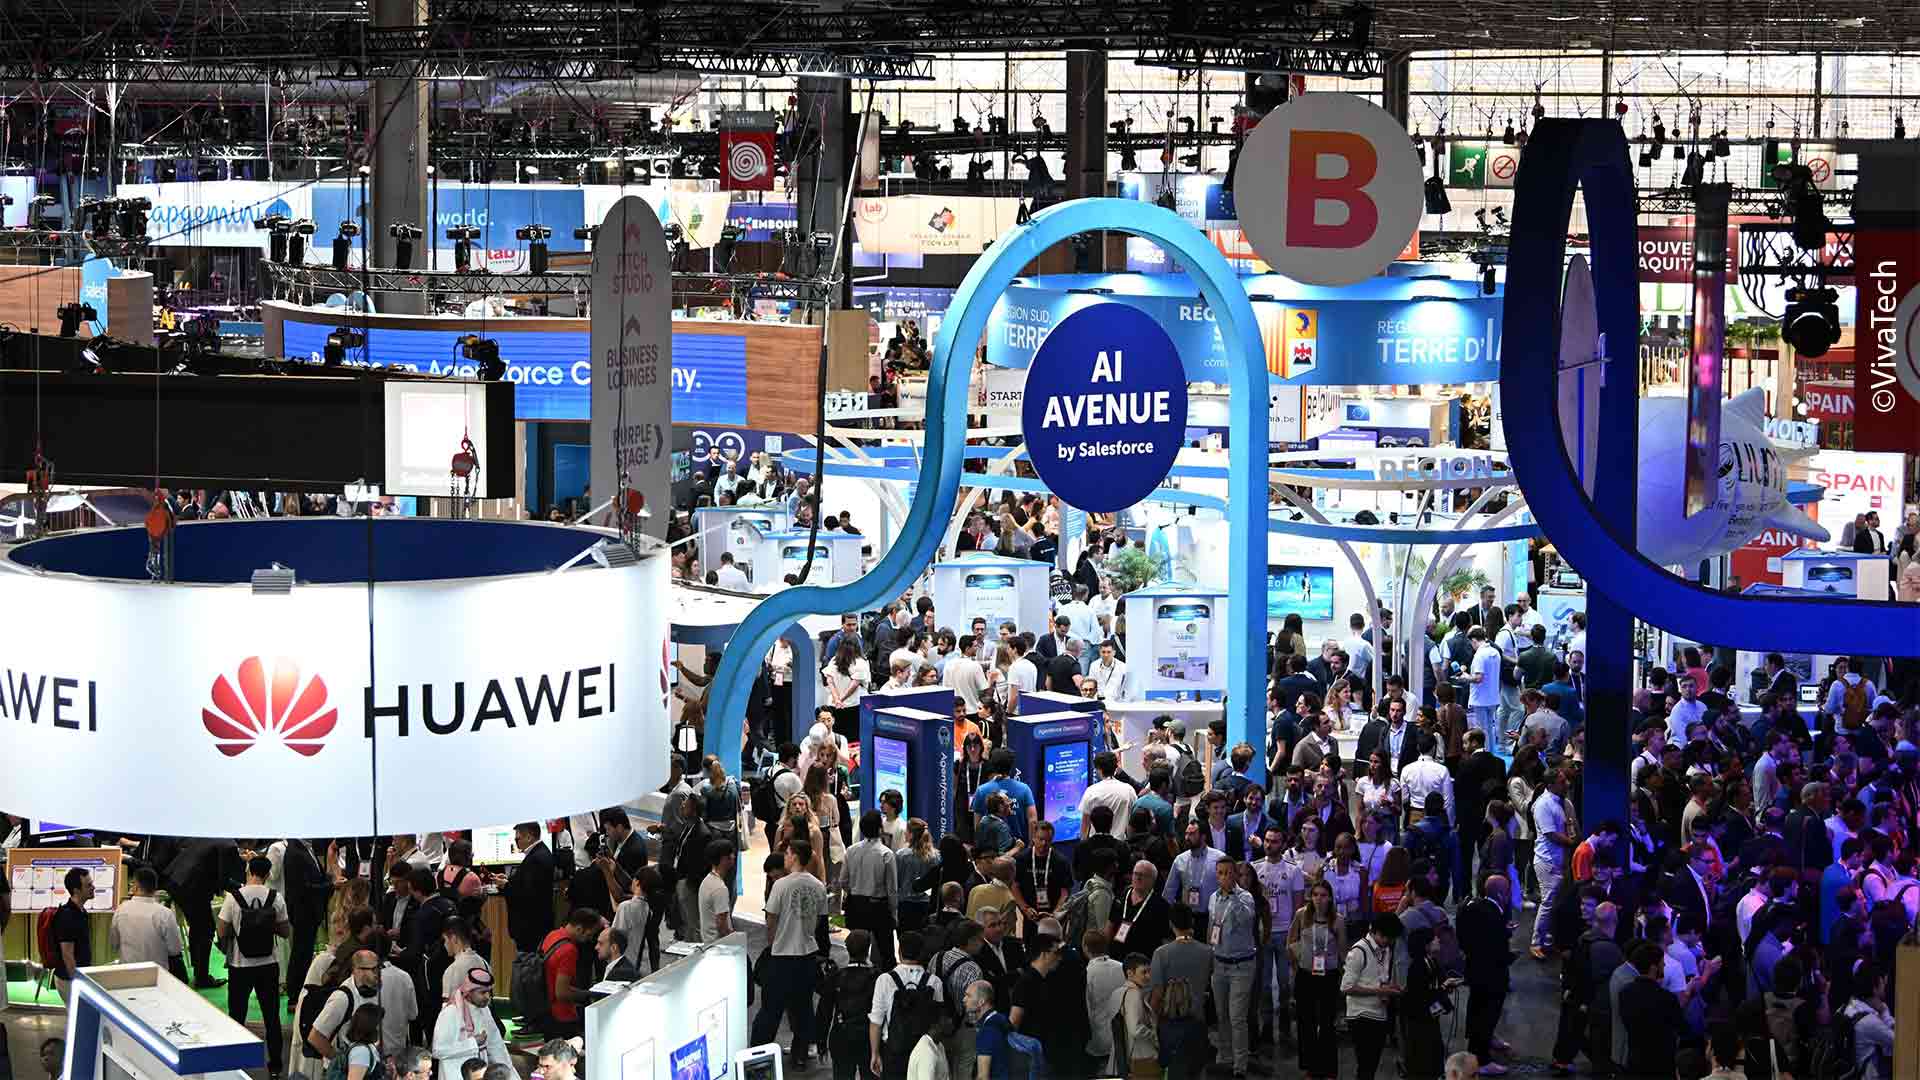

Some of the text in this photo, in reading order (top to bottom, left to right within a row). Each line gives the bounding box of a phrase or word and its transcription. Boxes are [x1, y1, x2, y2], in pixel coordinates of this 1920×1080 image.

[1286, 129, 1378, 248] B
[149, 200, 262, 236] apgemini
[437, 208, 494, 226] world.
[612, 272, 653, 294] STUDIO
[607, 344, 658, 368] BUSINESS
[1377, 338, 1458, 363] TERRE
[607, 367, 657, 390] LOUNGES
[1091, 351, 1122, 383] AI
[1042, 391, 1170, 428] AVENUE
[614, 424, 652, 448] PURPLE
[619, 446, 649, 468] STAGE
[1057, 441, 1154, 462] by Salesforce
[1379, 455, 1493, 481] REGION
[1815, 472, 1896, 493] SPAIN
[364, 664, 615, 738] HUAWEI
[939, 752, 948, 816] Agentforce
